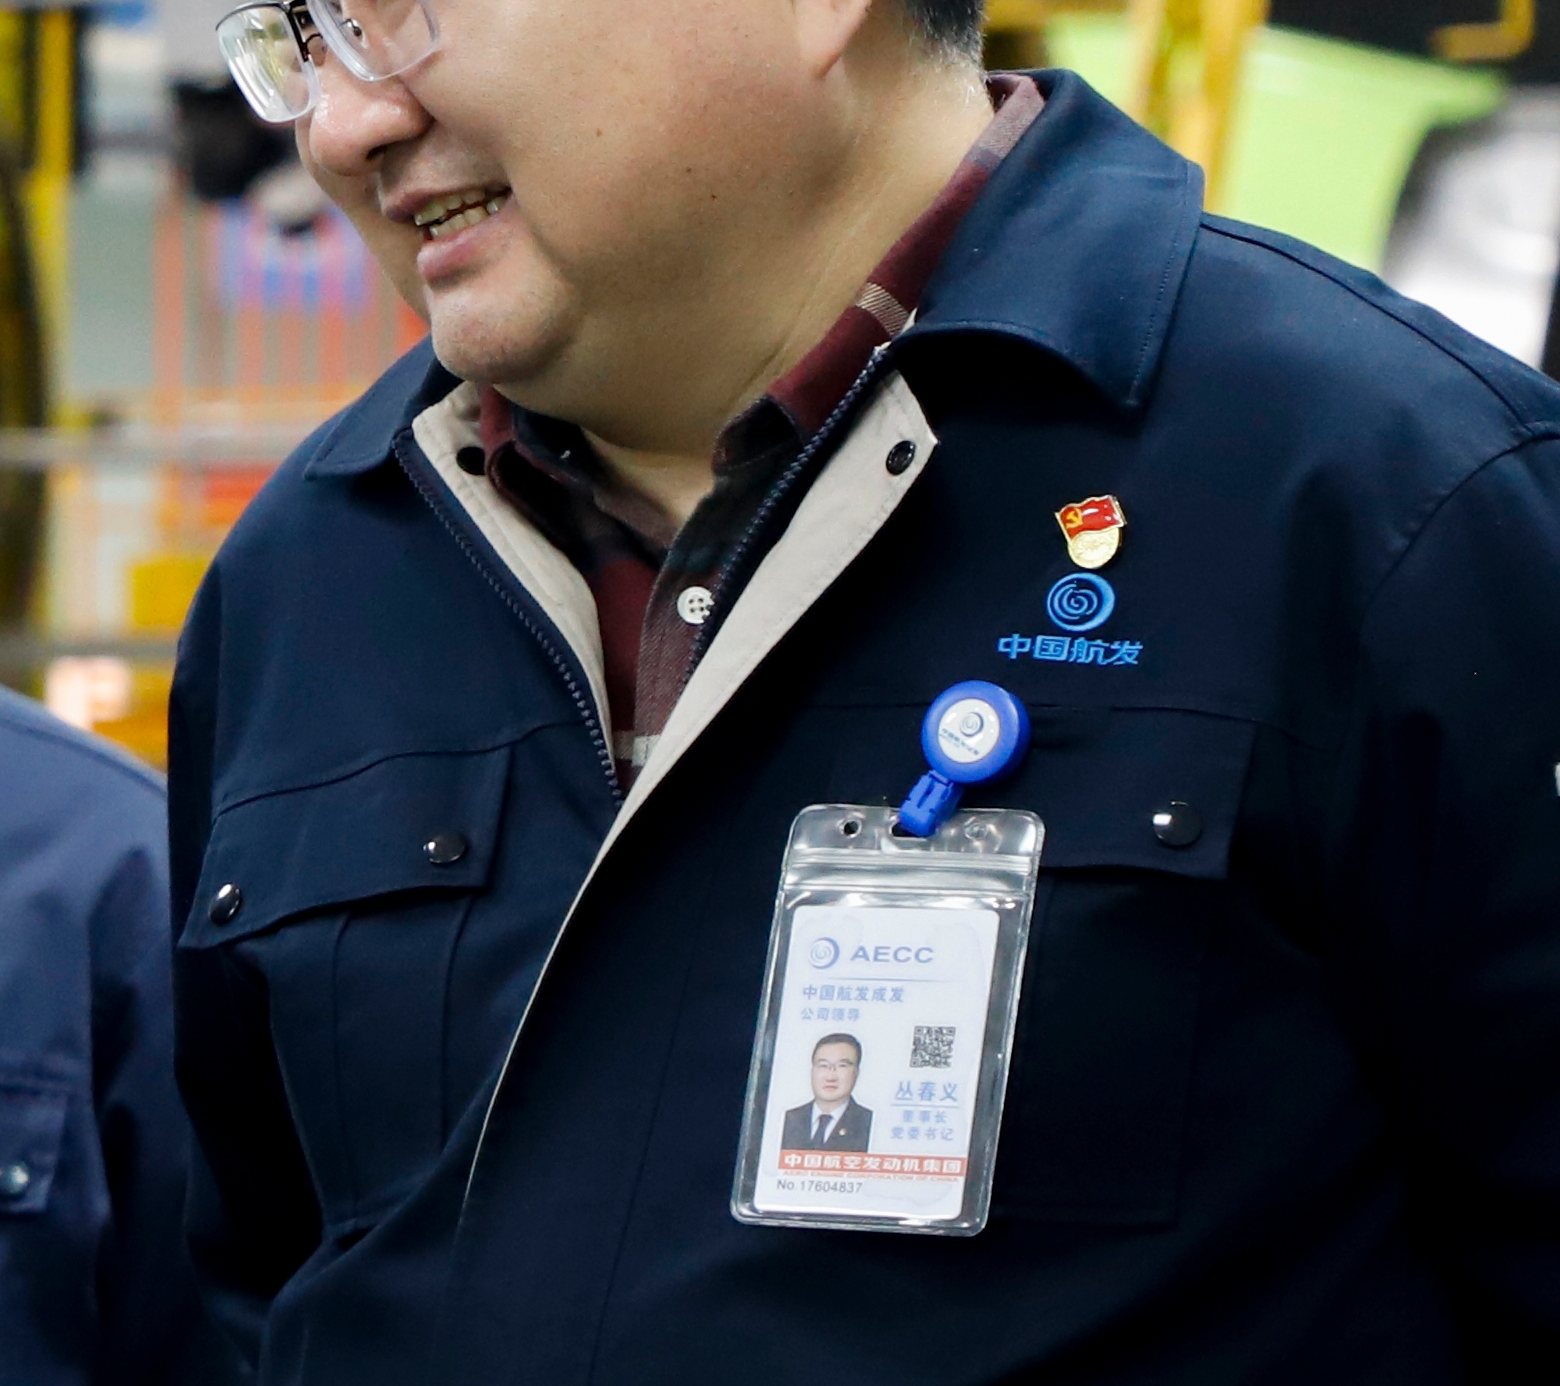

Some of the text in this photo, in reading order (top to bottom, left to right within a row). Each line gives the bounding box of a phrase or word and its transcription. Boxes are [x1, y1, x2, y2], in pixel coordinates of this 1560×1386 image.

[997, 633, 1143, 665] 中国航发
[850, 946, 935, 963] AECC
[802, 984, 905, 1003] 中国航发成发
[801, 1008, 861, 1022] 公司领导
[895, 1080, 958, 1102] 丛春义
[784, 1153, 962, 1174] 中国航空发动机集团
[800, 1180, 863, 1194] 17604837
